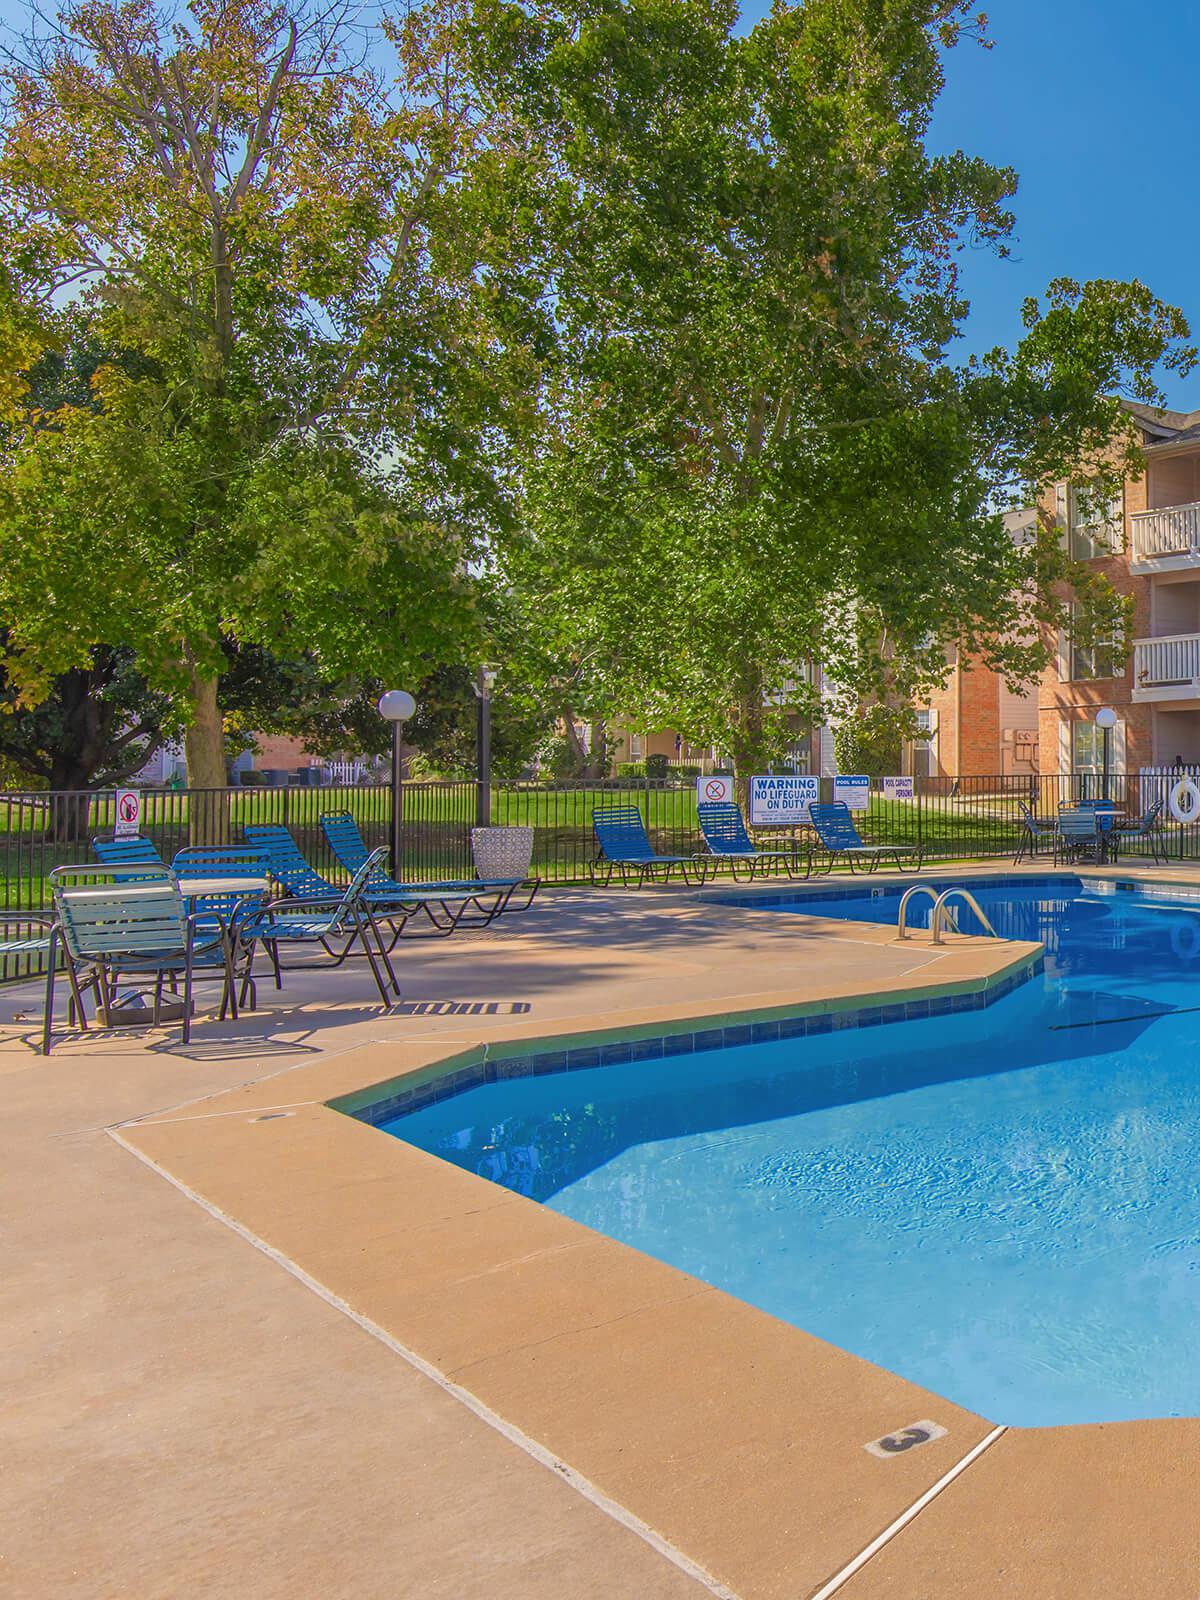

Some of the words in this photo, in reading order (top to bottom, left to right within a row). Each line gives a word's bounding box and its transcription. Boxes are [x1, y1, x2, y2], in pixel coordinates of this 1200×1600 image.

[757, 779, 815, 789] WARNING
[755, 790, 767, 800] NO
[769, 790, 817, 800] LIFEGUARD
[767, 800, 779, 809] ON
[782, 800, 805, 809] DUTY
[880, 1428, 930, 1452] 3
